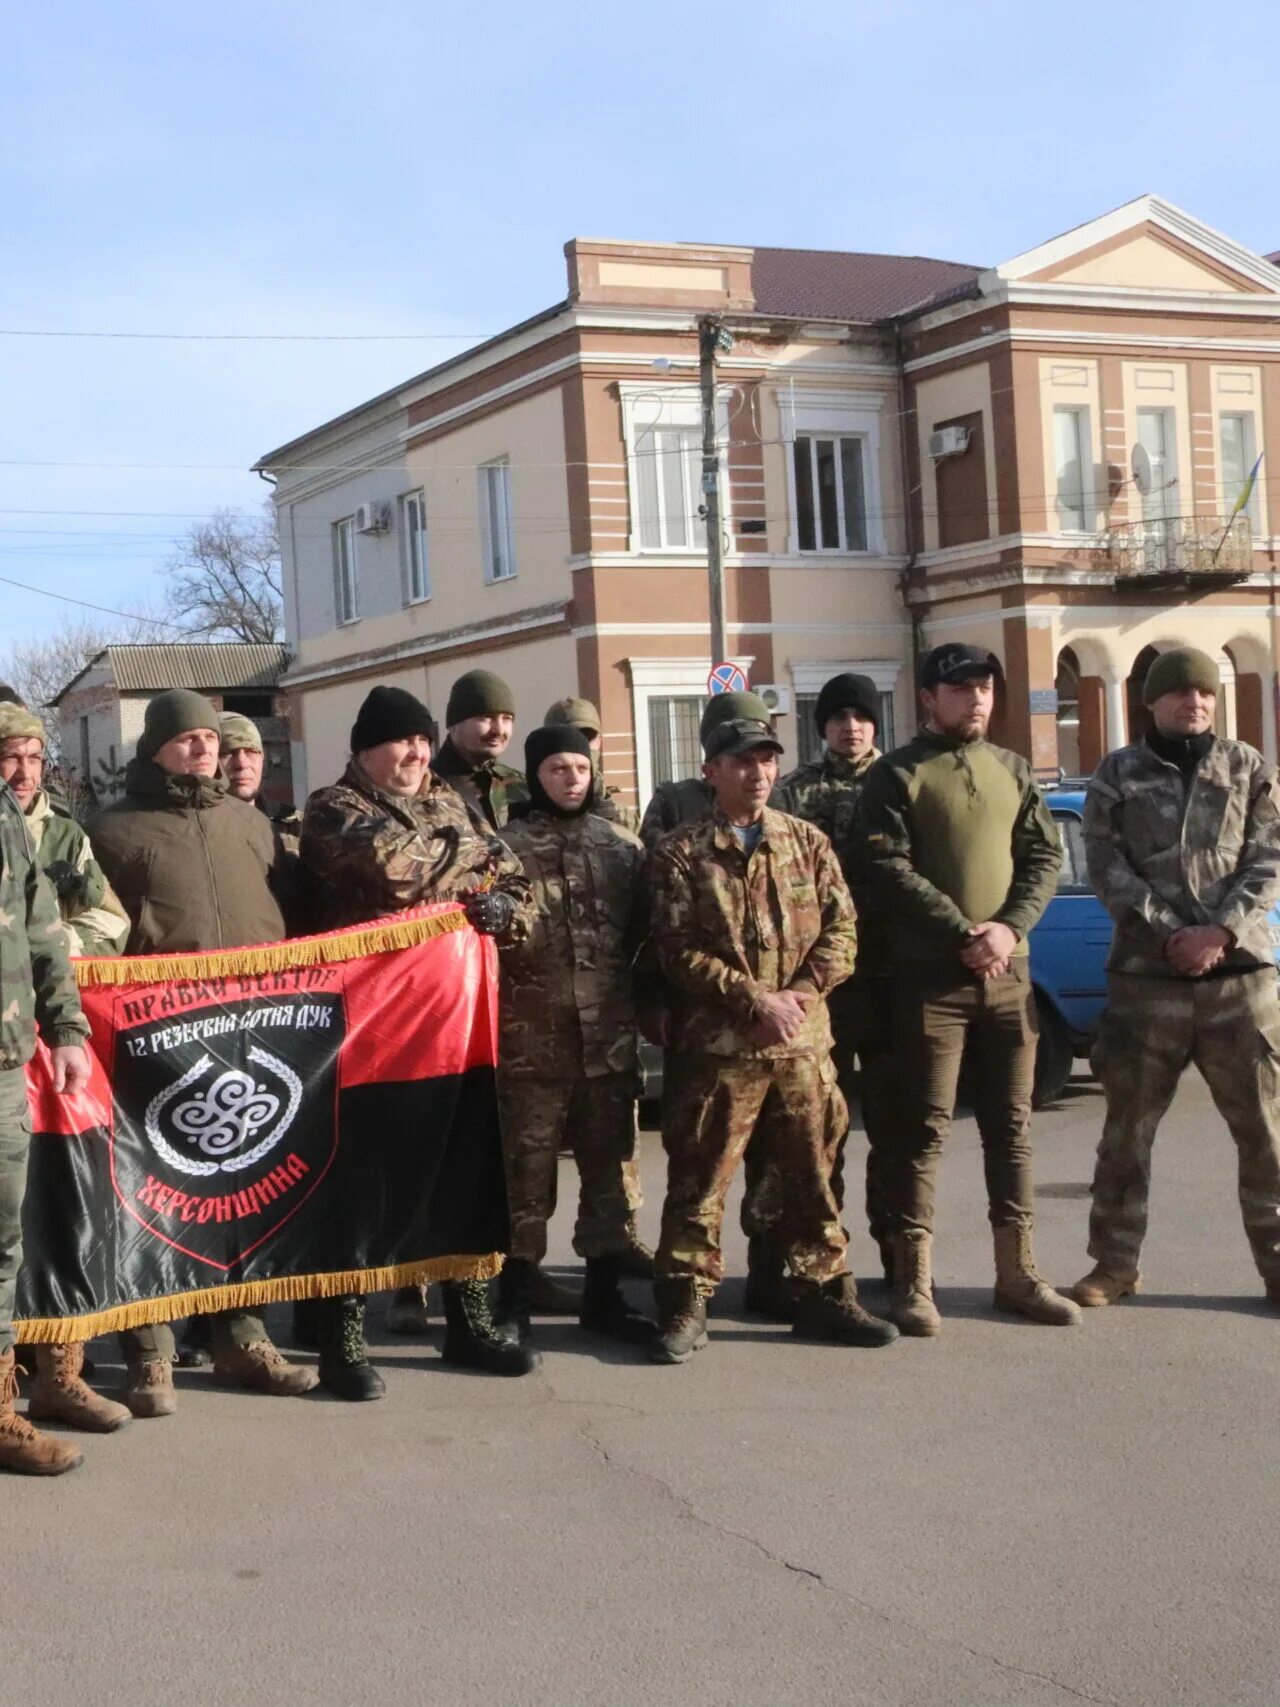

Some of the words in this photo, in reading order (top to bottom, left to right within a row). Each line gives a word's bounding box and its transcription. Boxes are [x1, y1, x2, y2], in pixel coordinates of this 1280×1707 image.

[126, 1036, 148, 1058] 12
[150, 1013, 237, 1054] РЕЗЕРВНА
[239, 1004, 295, 1030] СОТНЯ
[295, 1003, 334, 1031] ДУК
[136, 1151, 311, 1225] ХЕРСОНЩИНА
